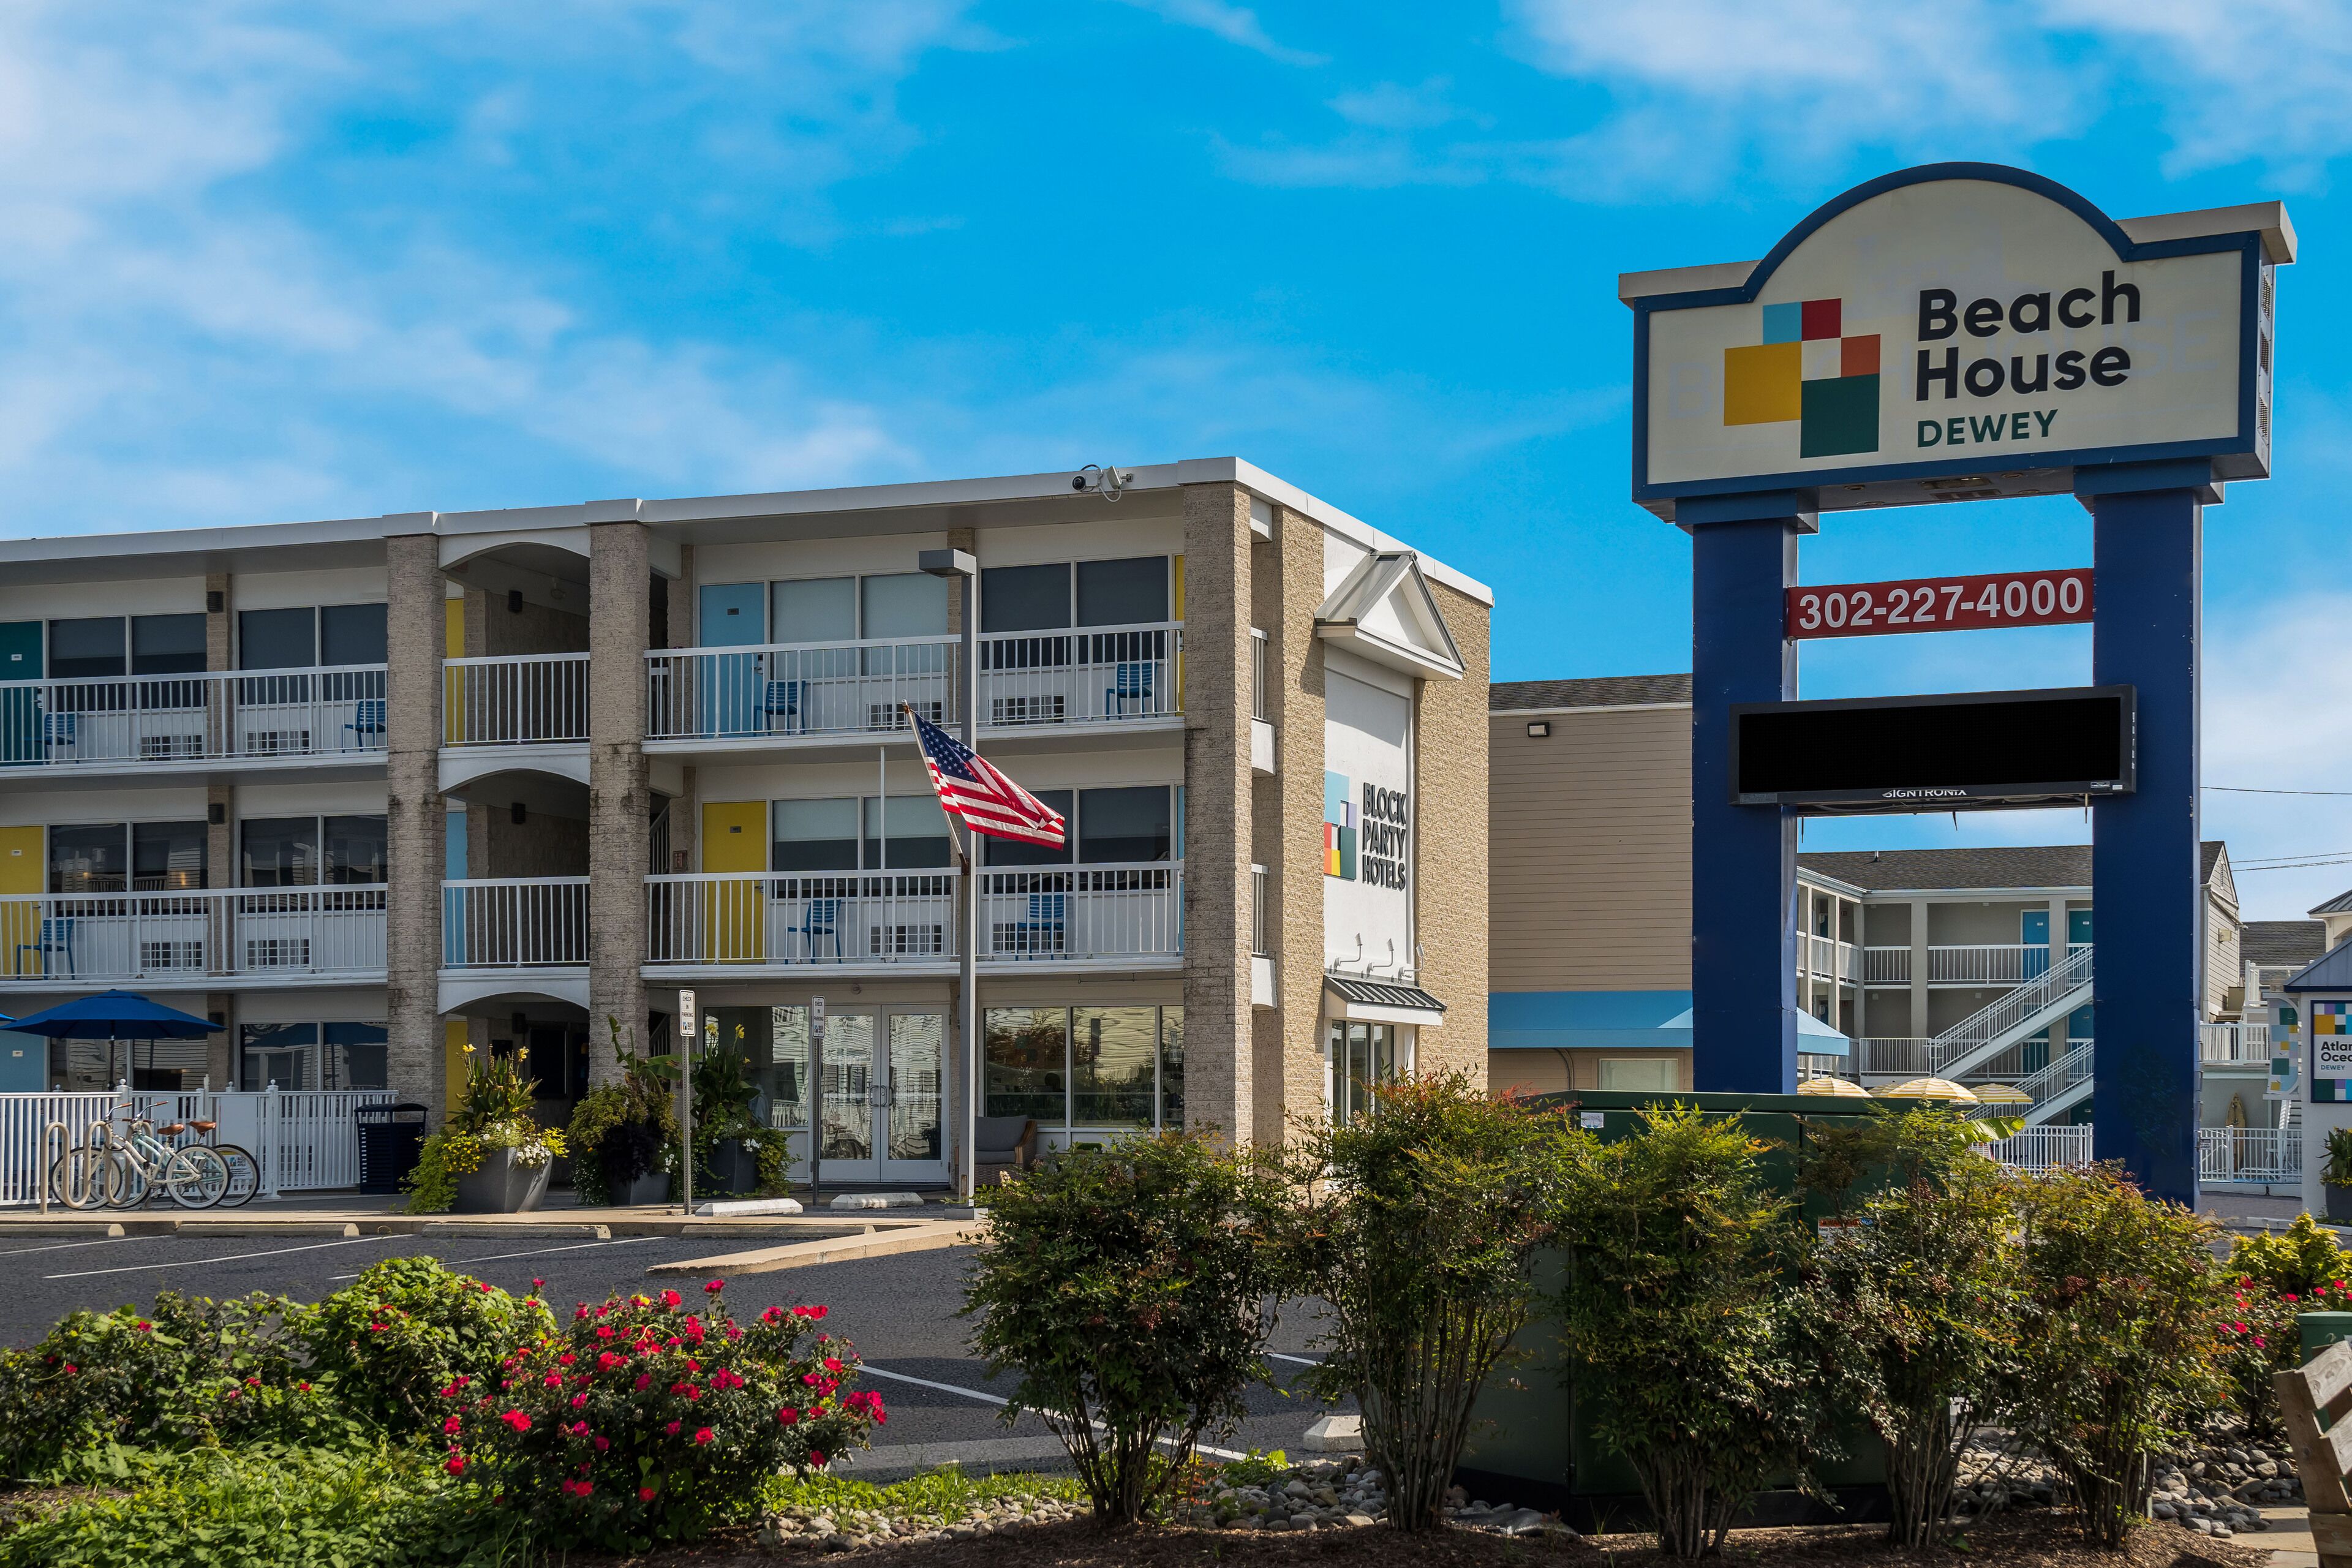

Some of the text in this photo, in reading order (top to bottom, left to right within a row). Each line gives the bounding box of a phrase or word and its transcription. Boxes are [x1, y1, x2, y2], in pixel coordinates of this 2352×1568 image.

[1918, 270, 2140, 342] Beach
[1916, 347, 2131, 402] House
[1917, 409, 2059, 448] DEWEY
[1799, 577, 2084, 630] 302-227-4000
[1363, 782, 1407, 825] BLOCK
[1363, 818, 1406, 860] PARTY
[1362, 854, 1406, 891] HOTELS
